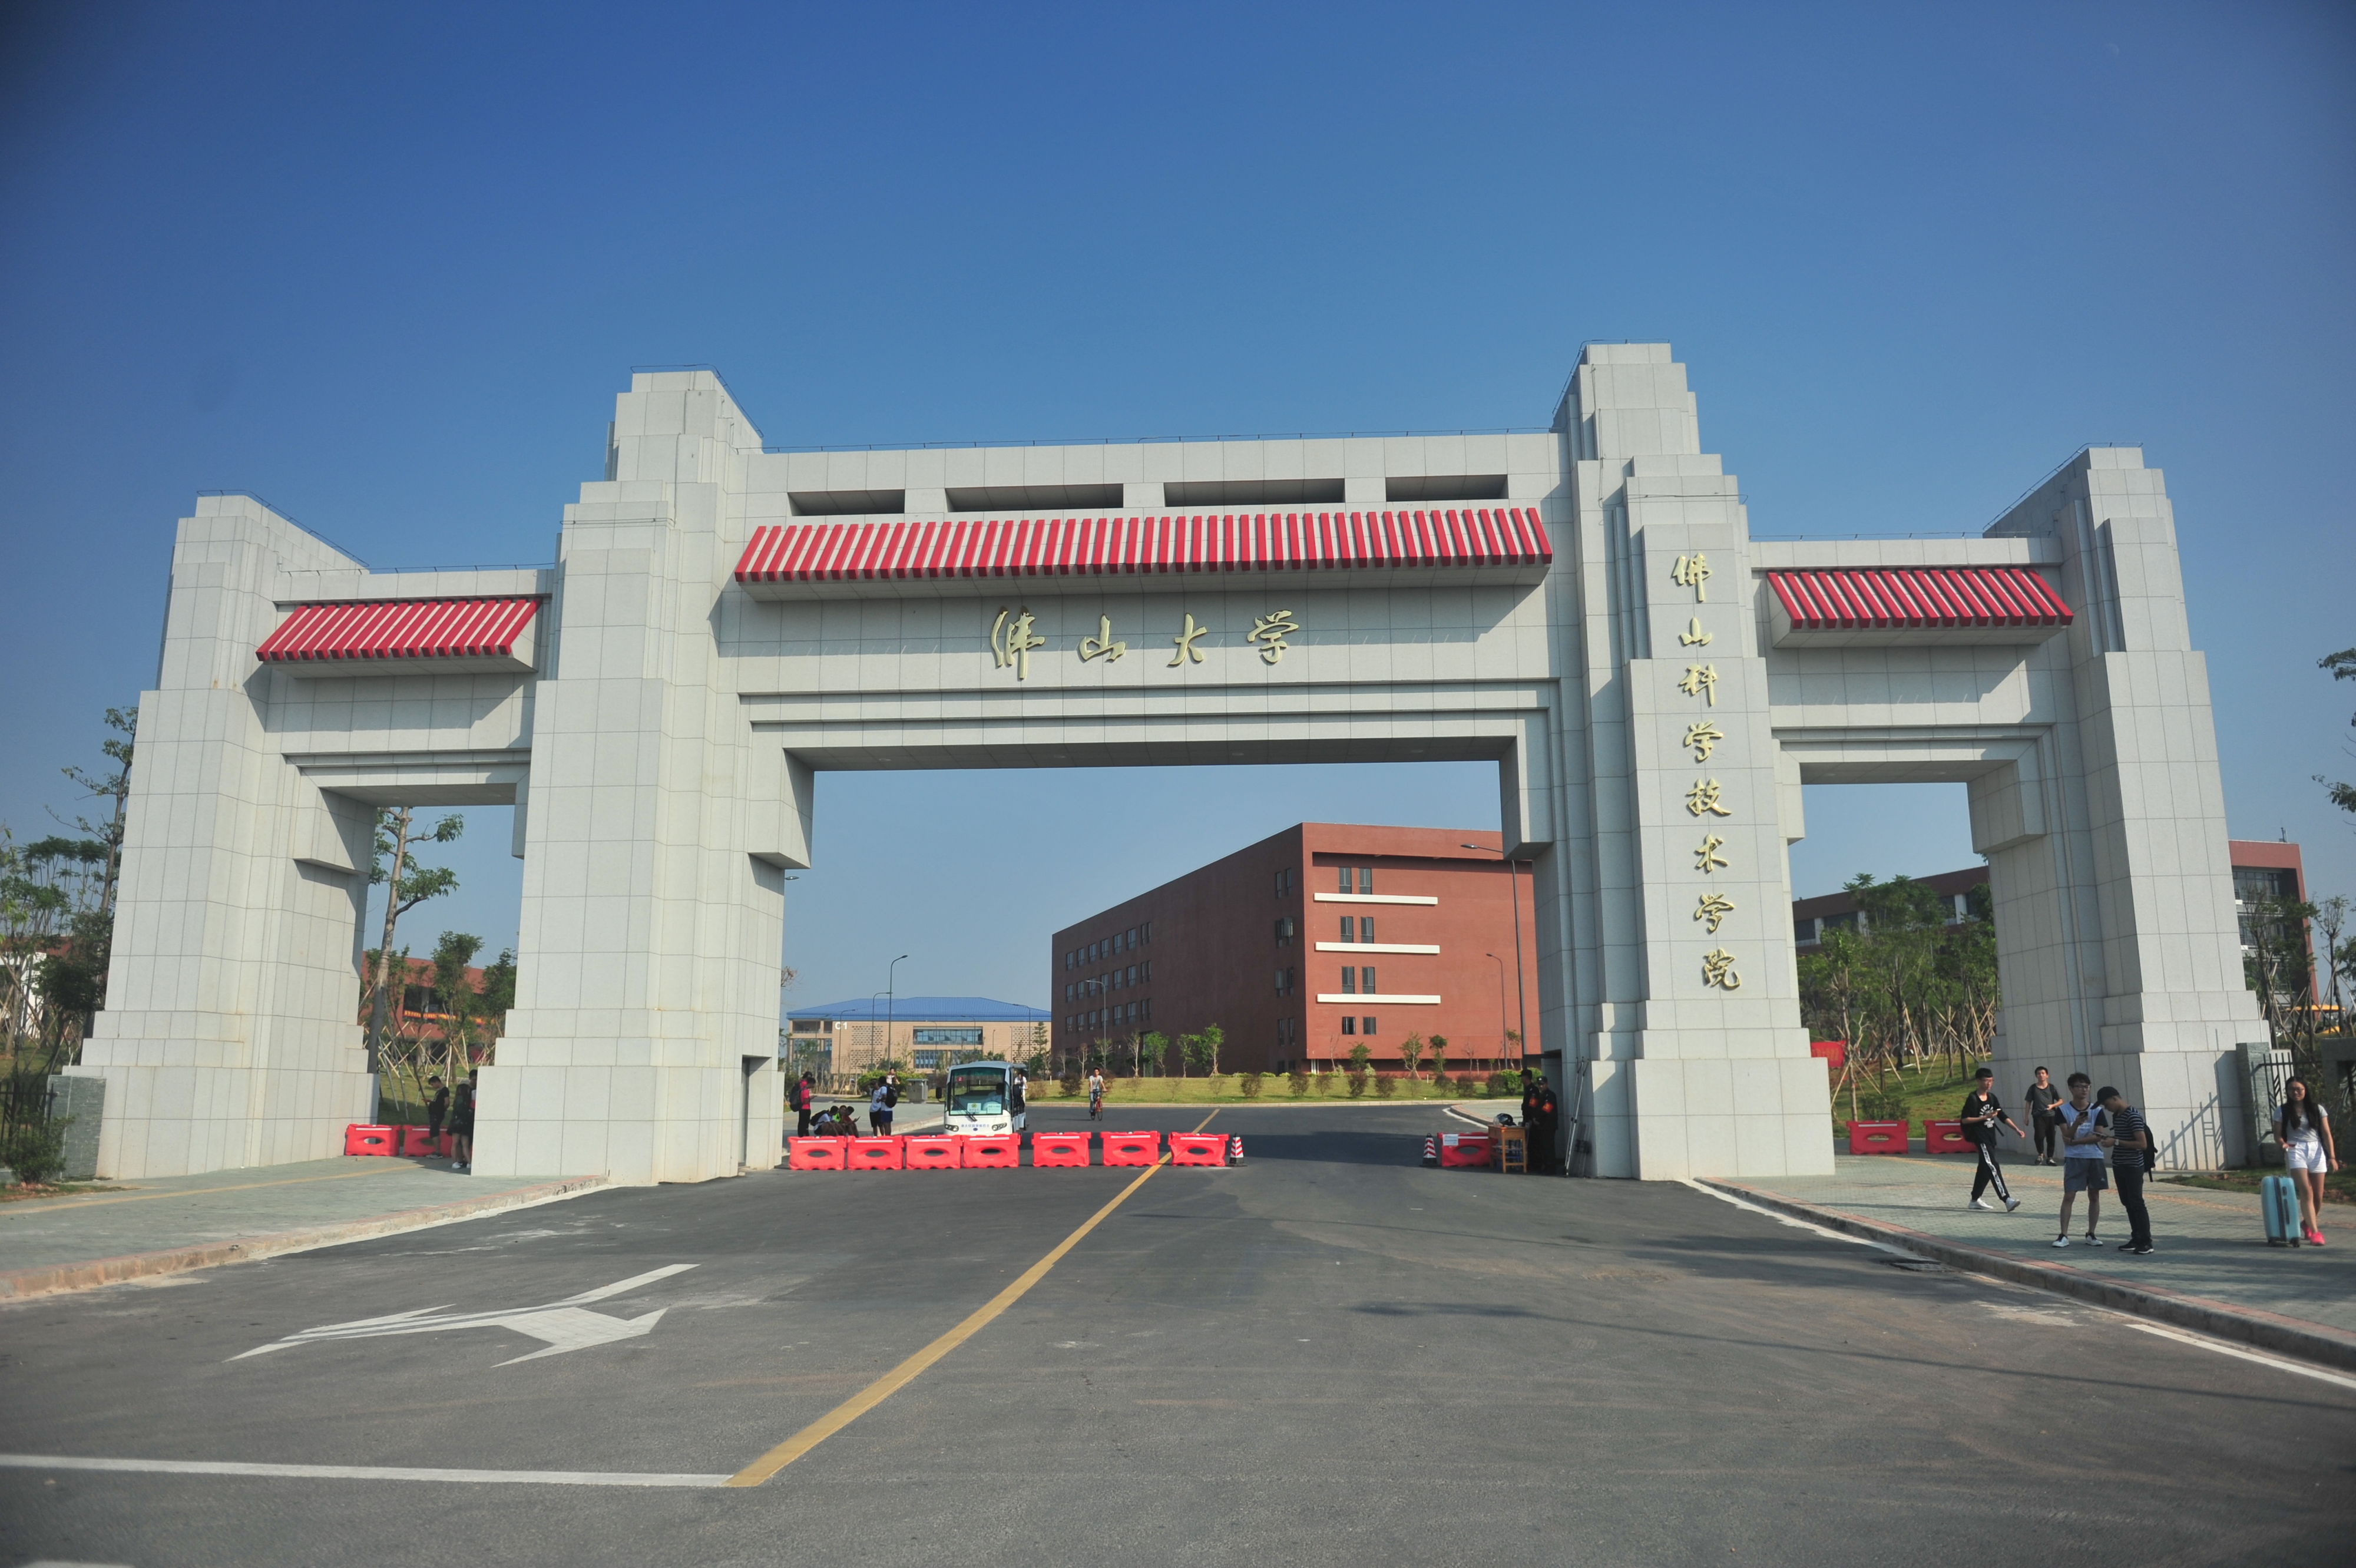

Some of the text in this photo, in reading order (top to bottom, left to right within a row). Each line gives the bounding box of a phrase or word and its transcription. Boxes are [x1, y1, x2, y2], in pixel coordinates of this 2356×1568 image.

[991, 610, 1299, 680] 佛山大学
[1672, 553, 1741, 990] 佛山科学技术学院
[835, 1021, 848, 1030] C1
